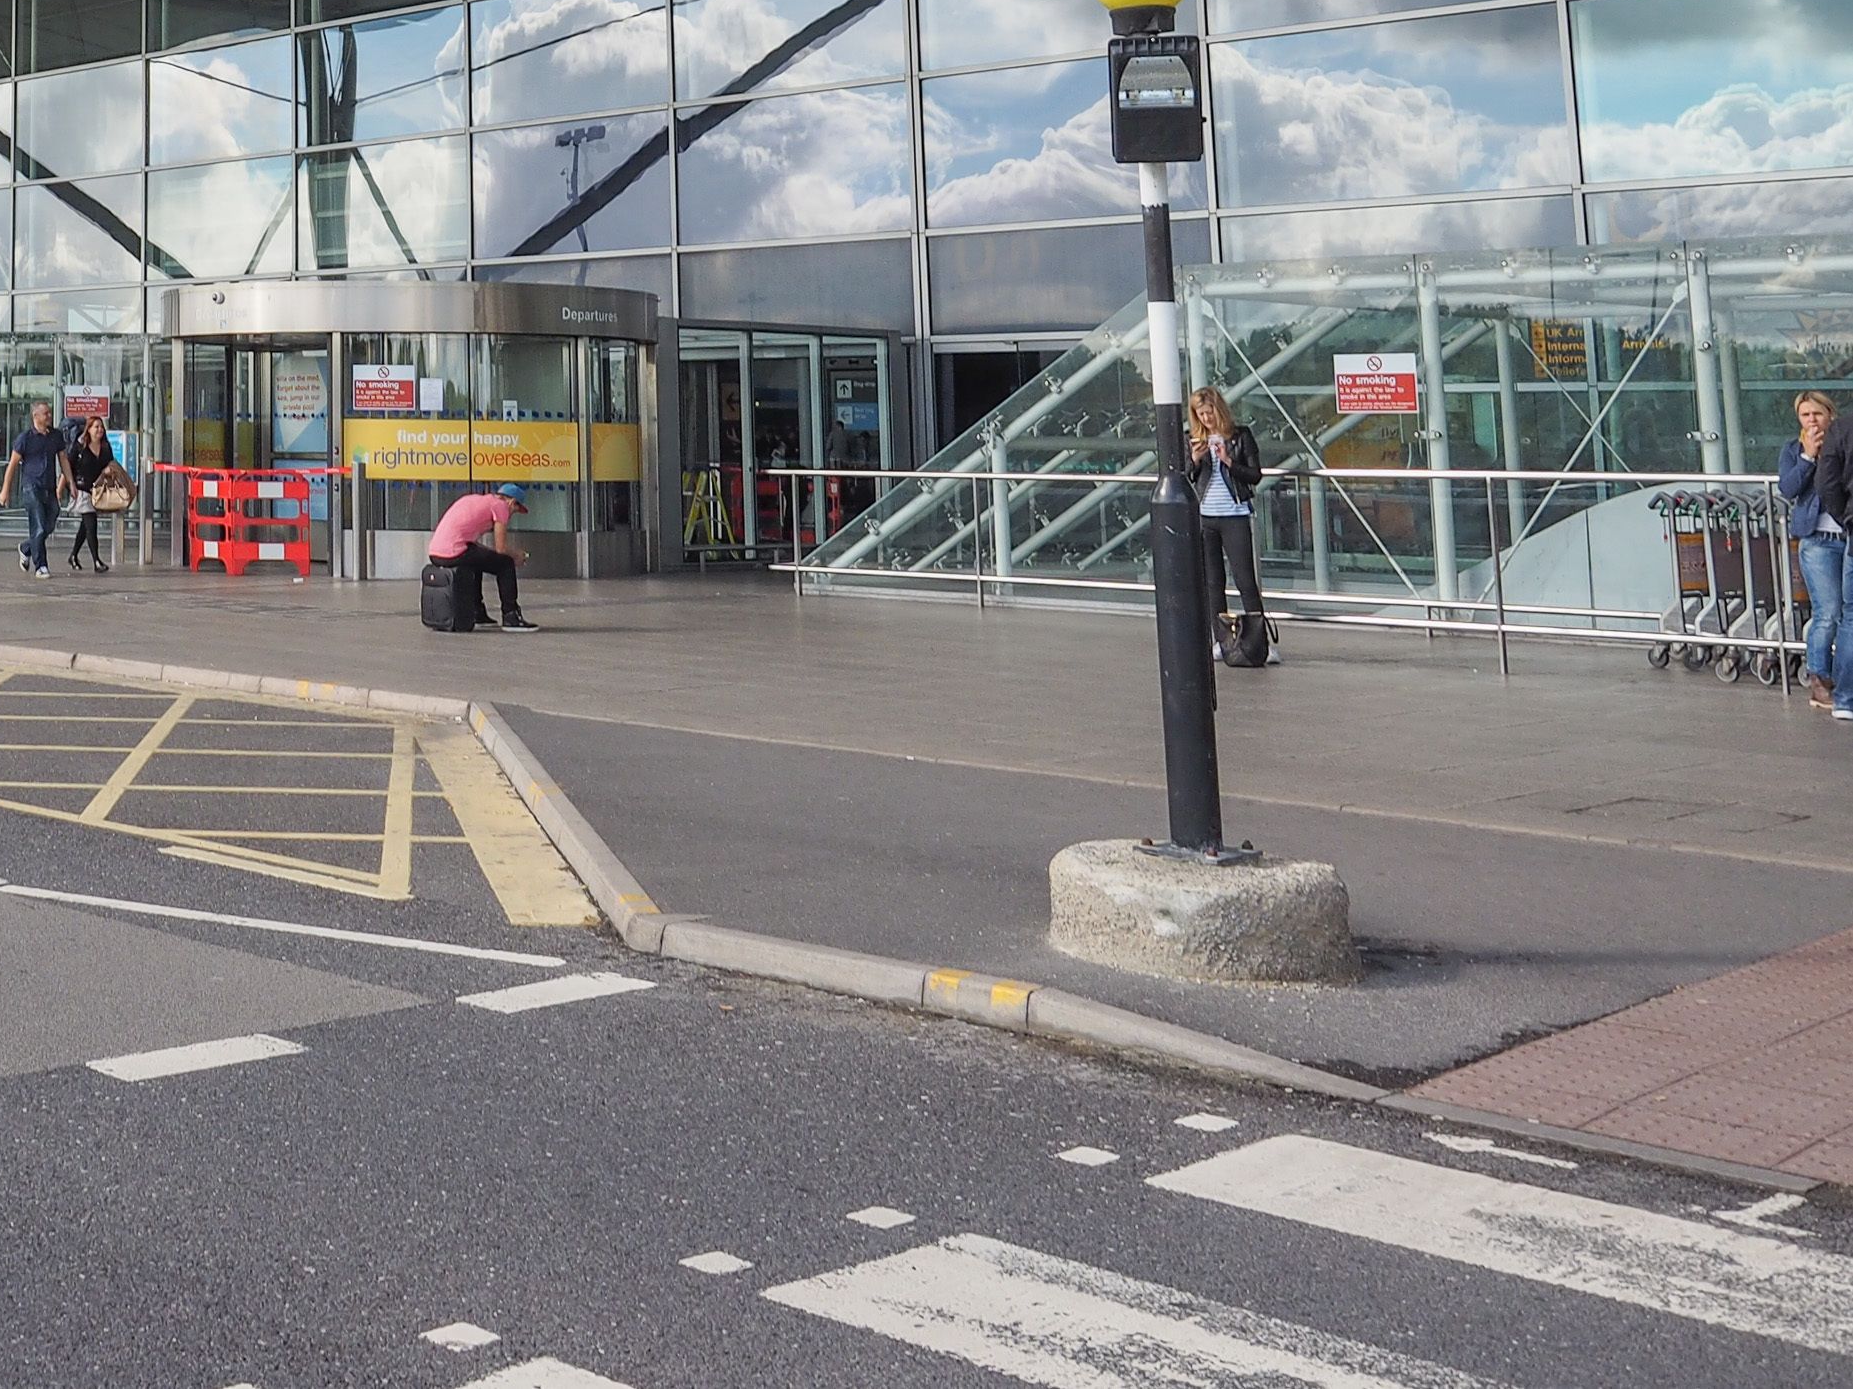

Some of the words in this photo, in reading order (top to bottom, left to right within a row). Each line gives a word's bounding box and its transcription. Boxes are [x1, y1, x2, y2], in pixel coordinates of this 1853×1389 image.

[562, 306, 618, 323] Departures
[369, 381, 399, 389] smoking
[1339, 376, 1352, 385] No
[1356, 375, 1396, 386] smoking
[397, 430, 427, 443] find
[432, 433, 467, 448] your
[473, 432, 519, 448] happy
[374, 447, 468, 469] rightmove
[473, 452, 571, 468] overseas.com
